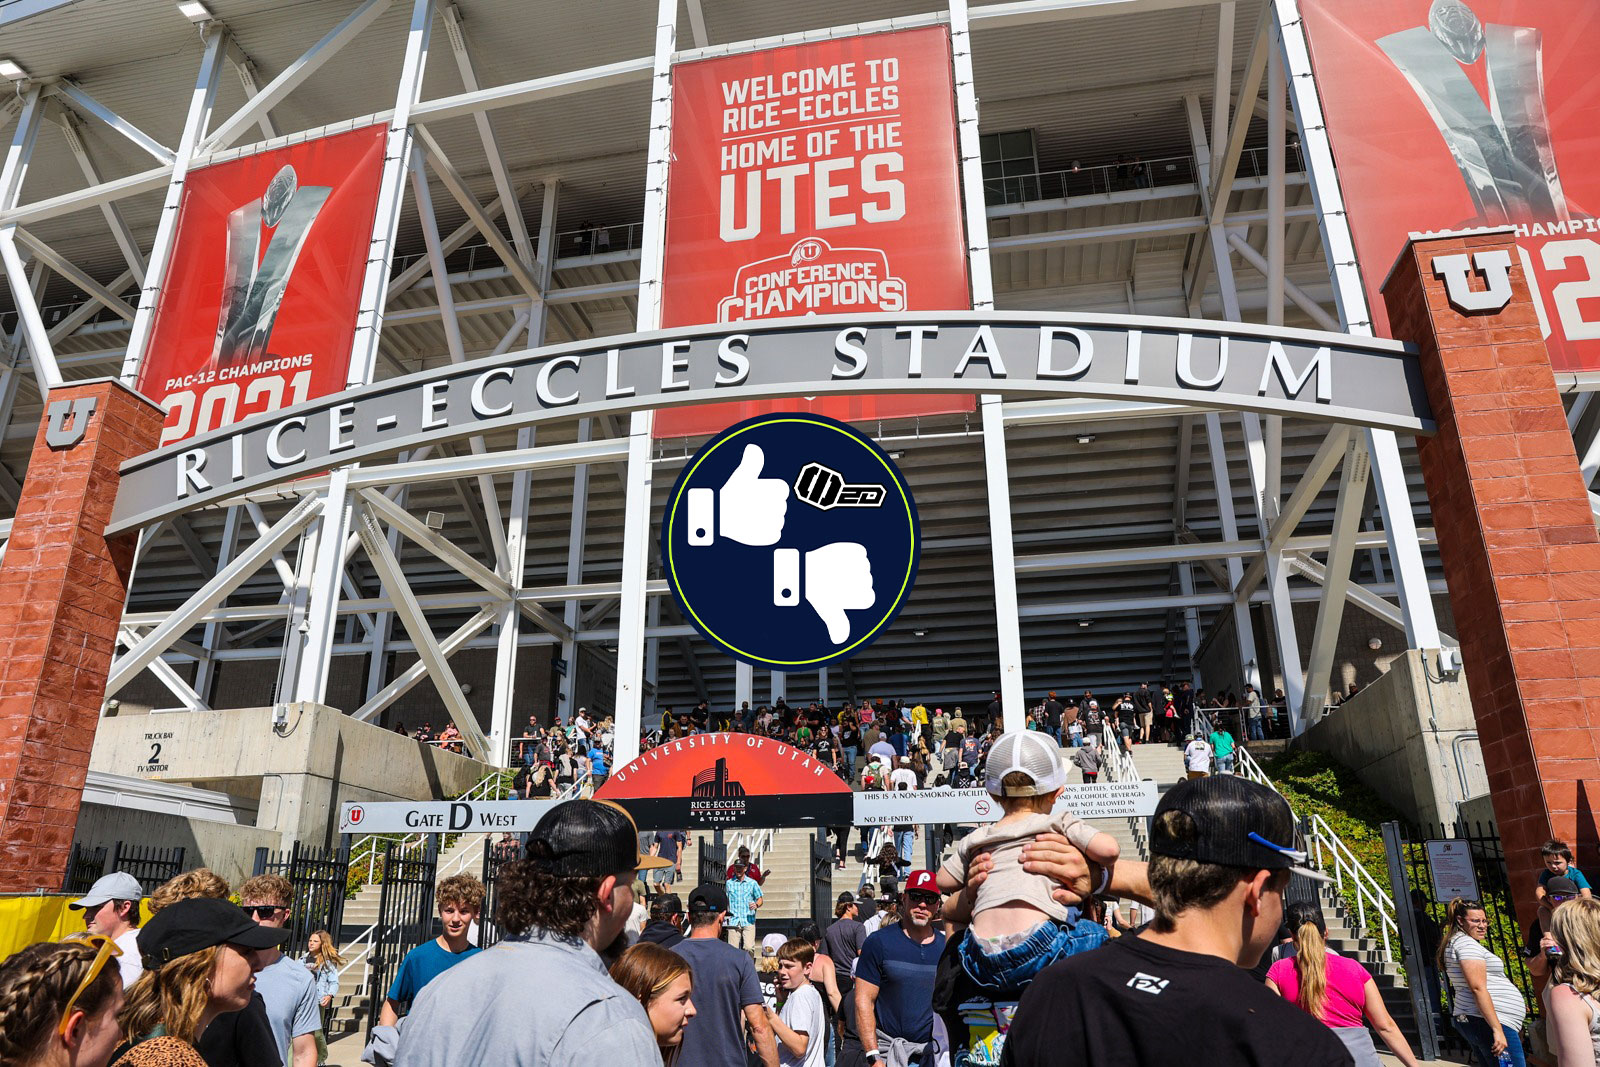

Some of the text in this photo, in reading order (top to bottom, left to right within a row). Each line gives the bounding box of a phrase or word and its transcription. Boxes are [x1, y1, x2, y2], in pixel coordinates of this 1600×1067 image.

[721, 57, 899, 105] WELCOME TO
[722, 85, 899, 134] RICE-ECCLES
[720, 121, 903, 171] HOME OF THE
[719, 151, 906, 243] UTES
[1499, 219, 1600, 238] HAMPI
[745, 262, 877, 295] CONFERENCE
[1432, 249, 1513, 311] U
[721, 279, 904, 323] CHAMPIONS
[164, 353, 313, 391] PAC-12 CHAMPIONS
[47, 397, 98, 448] U
[176, 324, 1332, 498] RICE-ECCLES STADIUM
[144, 732, 163, 740] TRUCK
[148, 742, 162, 764] 2
[146, 764, 169, 772] VISITOR
[617, 734, 825, 782] UNIVERSITY OF UTAH
[900, 791, 956, 799] NON-SMOKING
[448, 802, 473, 831] D
[878, 815, 914, 823] RE-ENTRY
[917, 872, 931, 886] P
